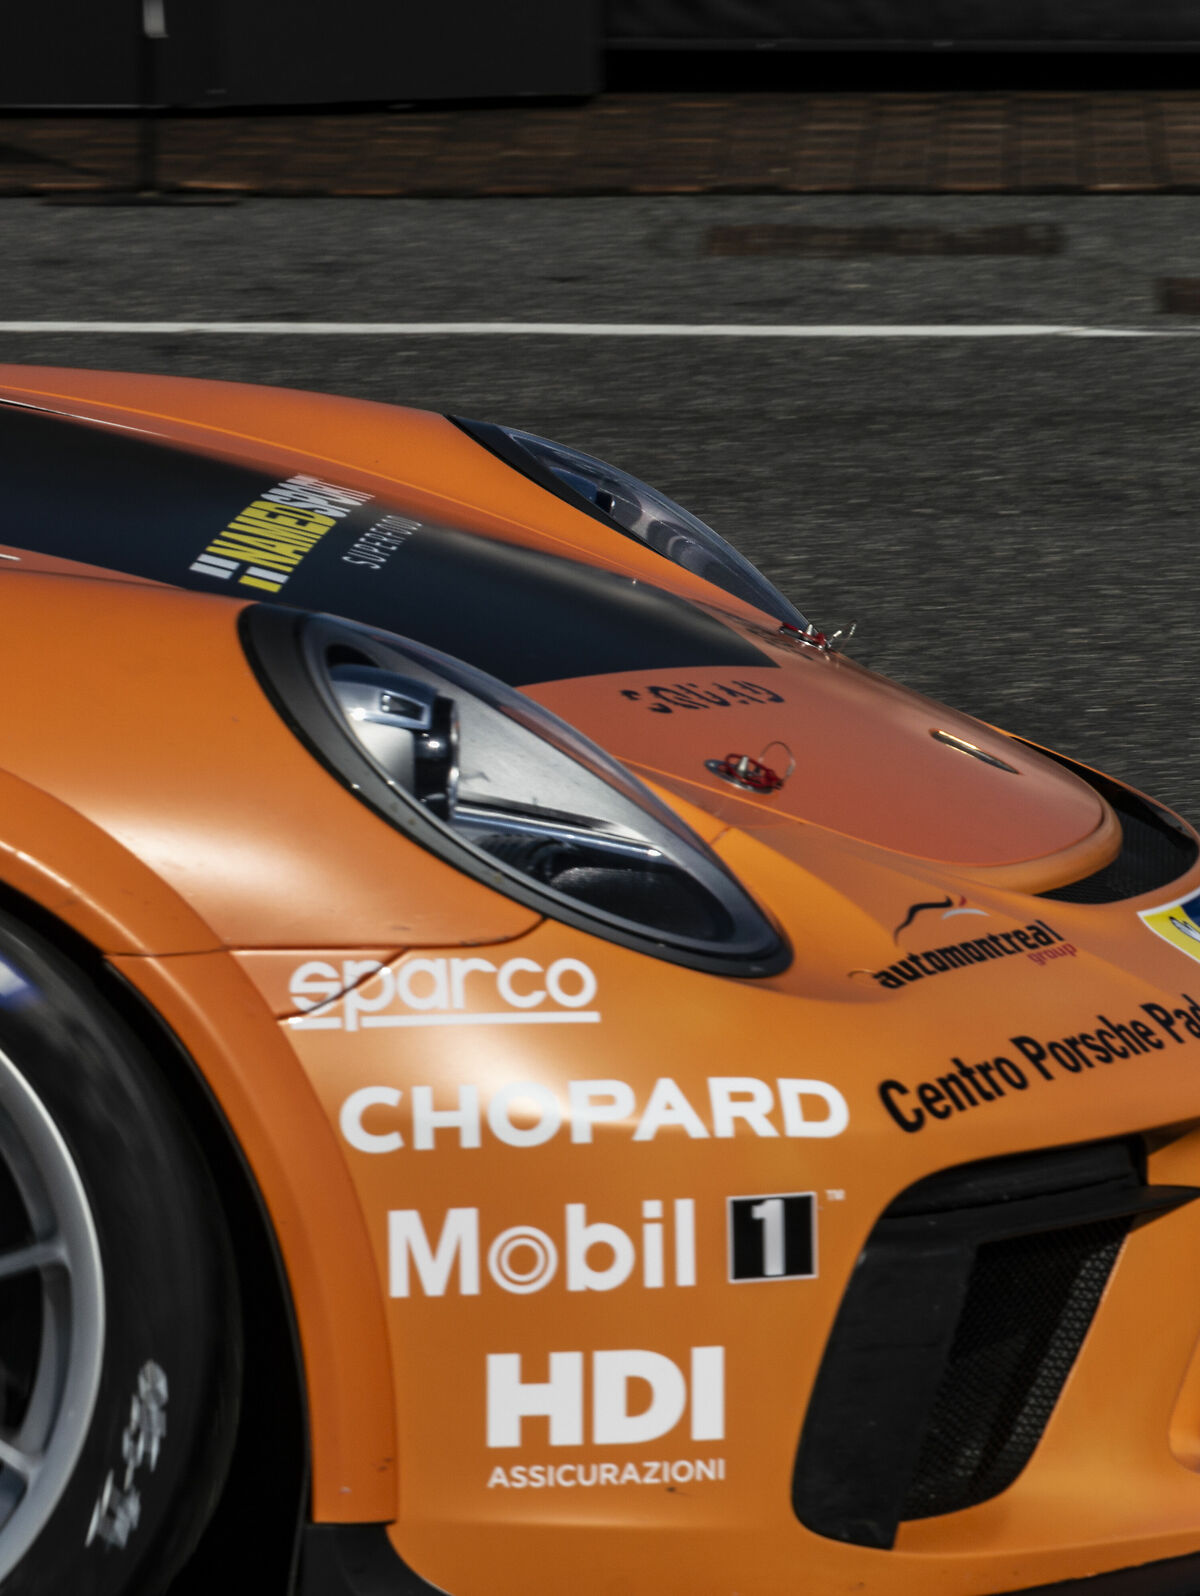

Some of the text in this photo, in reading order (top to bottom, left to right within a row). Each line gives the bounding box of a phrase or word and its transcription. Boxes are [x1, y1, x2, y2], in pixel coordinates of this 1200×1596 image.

[871, 919, 1066, 990] automontreal
[1026, 943, 1079, 967] group
[288, 957, 598, 1032] sparco
[877, 1057, 1029, 1134] Centro
[1009, 1015, 1166, 1081] Porsche
[339, 1076, 851, 1155] CHOPARD
[387, 1198, 697, 1299] Mobil
[486, 1345, 726, 1449] HDI
[486, 1457, 727, 1490] ASSICURAZIONI
